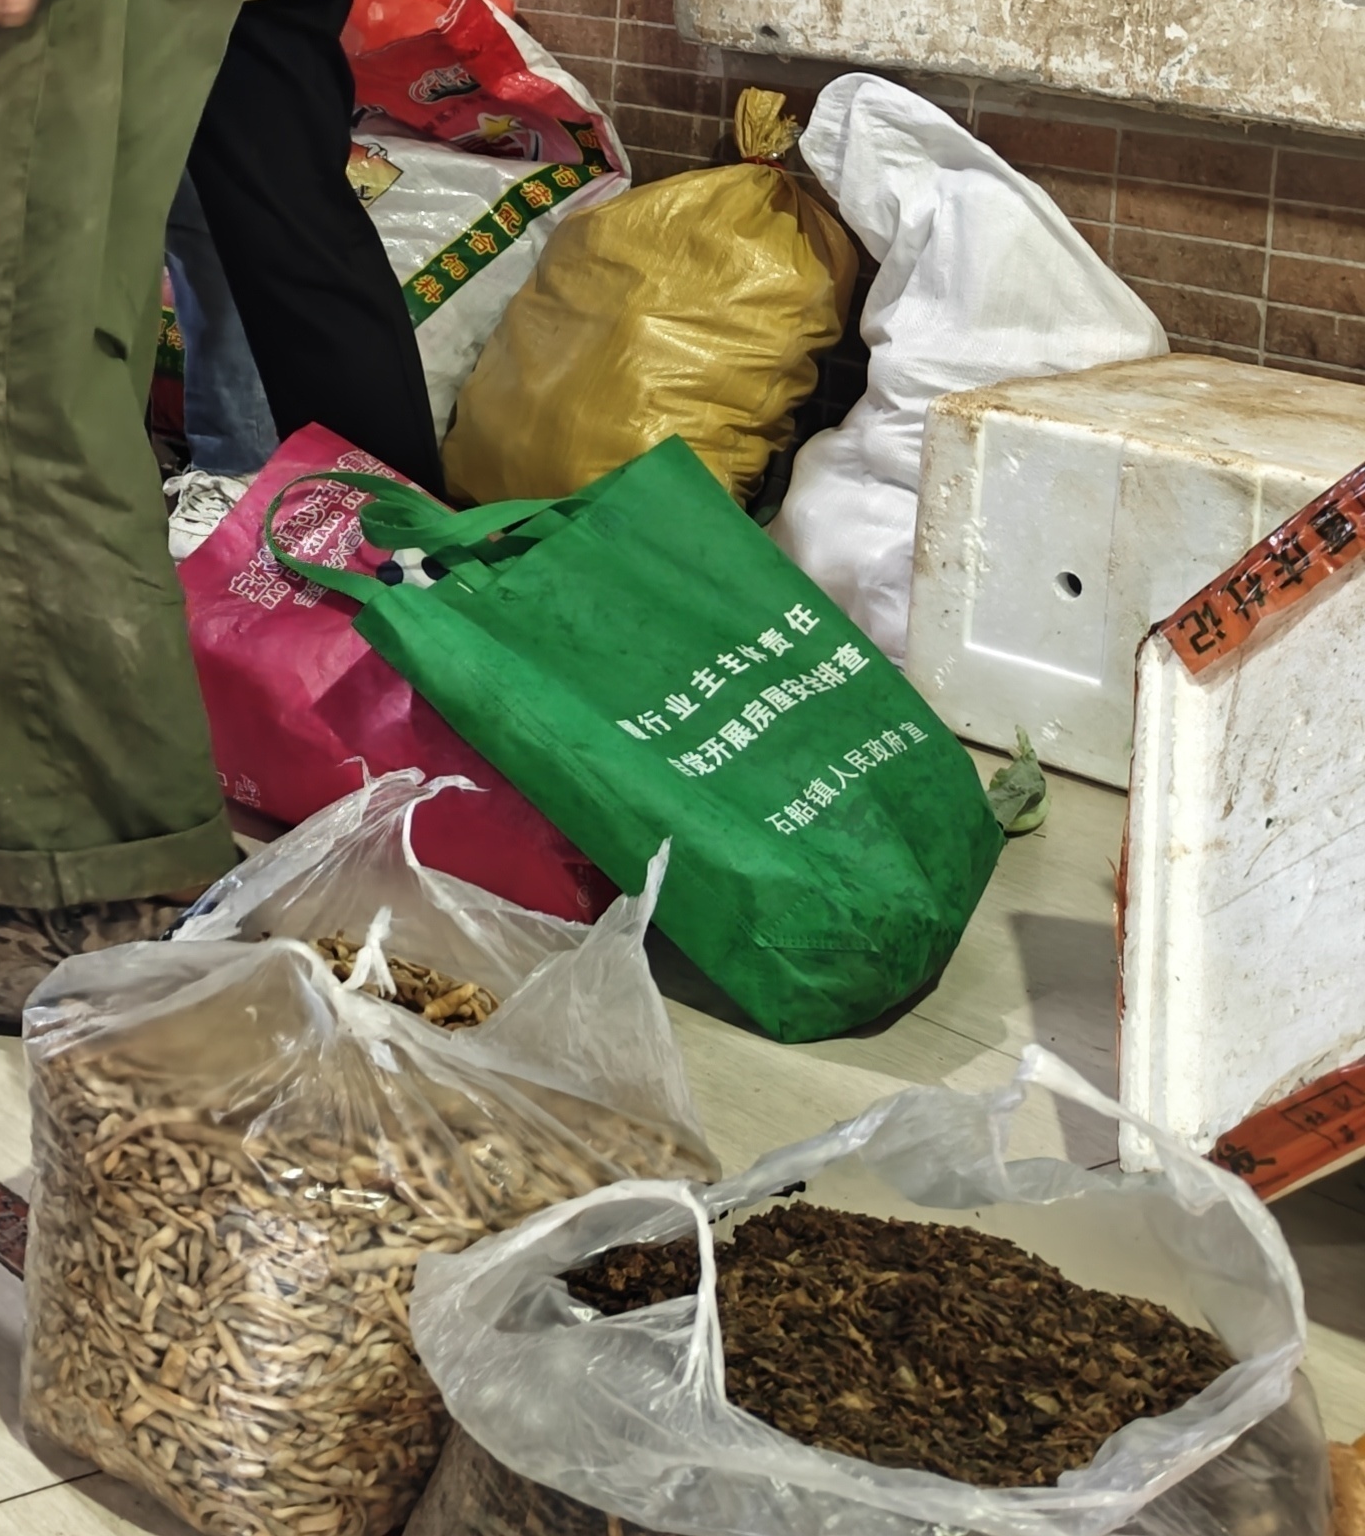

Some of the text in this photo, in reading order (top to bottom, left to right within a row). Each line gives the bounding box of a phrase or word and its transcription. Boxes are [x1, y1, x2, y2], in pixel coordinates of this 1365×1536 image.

[260, 581, 291, 610] BAO
[303, 511, 345, 556] XIANG
[764, 721, 928, 835] 石船镇人民政府宣
